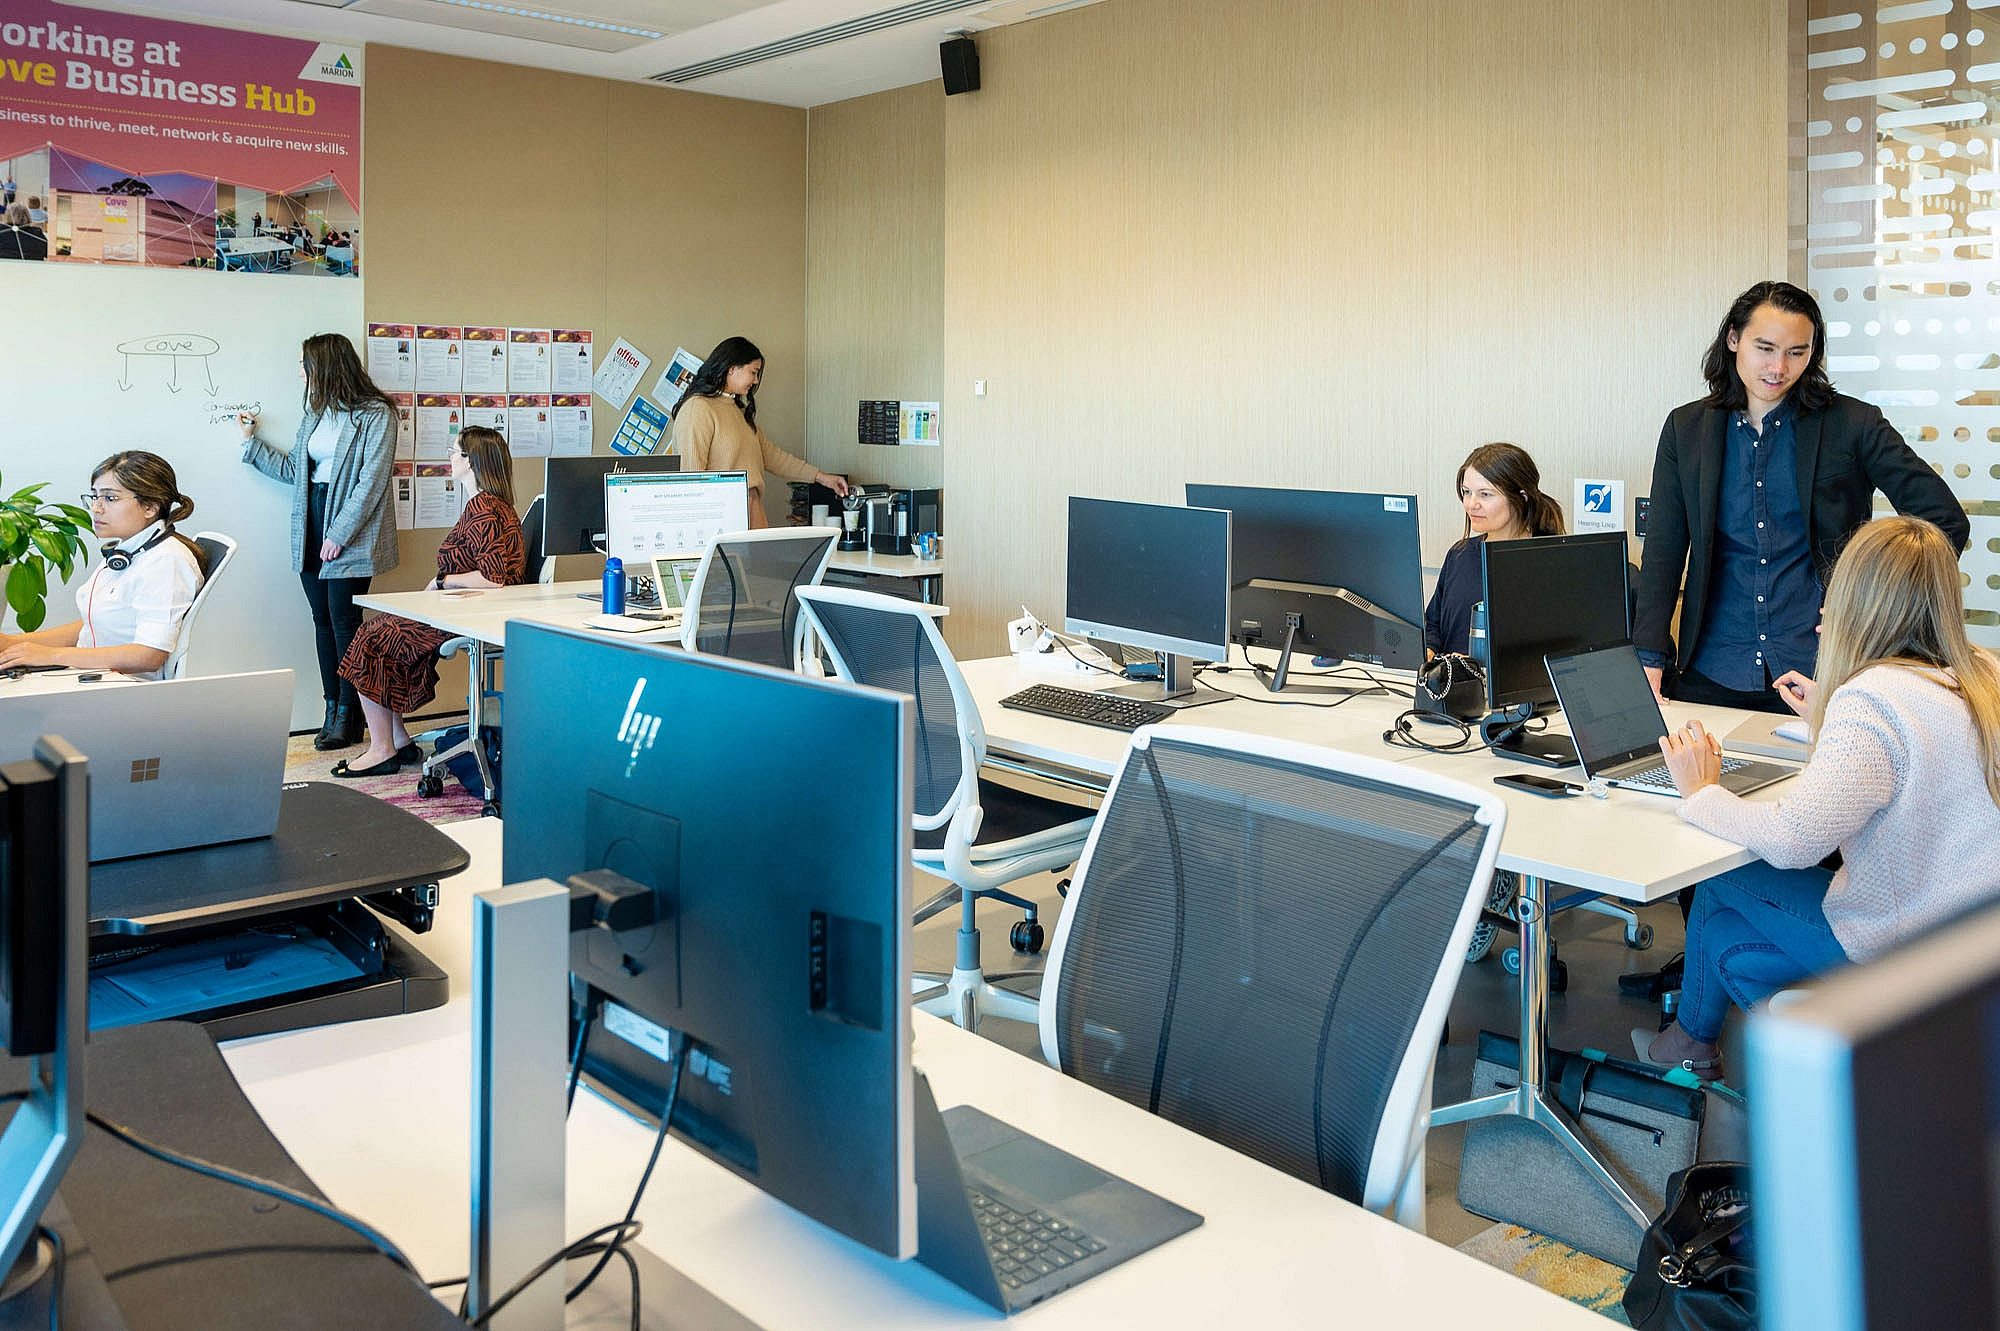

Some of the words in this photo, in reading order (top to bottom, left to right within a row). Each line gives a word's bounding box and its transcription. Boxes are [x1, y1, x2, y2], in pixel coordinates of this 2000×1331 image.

[0, 21, 135, 68] orking
[143, 40, 181, 67] at
[321, 66, 354, 78] MARION
[65, 60, 237, 107] Business
[245, 83, 316, 116] Hub
[50, 114, 65, 126] to
[68, 116, 115, 132] thrive,
[118, 122, 159, 137] meet,
[162, 127, 219, 142] network
[222, 132, 233, 144] &
[235, 134, 283, 149] acquire
[285, 138, 312, 152] new
[314, 141, 349, 156] skills.
[104, 197, 128, 206] Cove
[616, 347, 640, 368] office
[1577, 519, 1600, 529] Hearing
[1601, 521, 1616, 529] Loop
